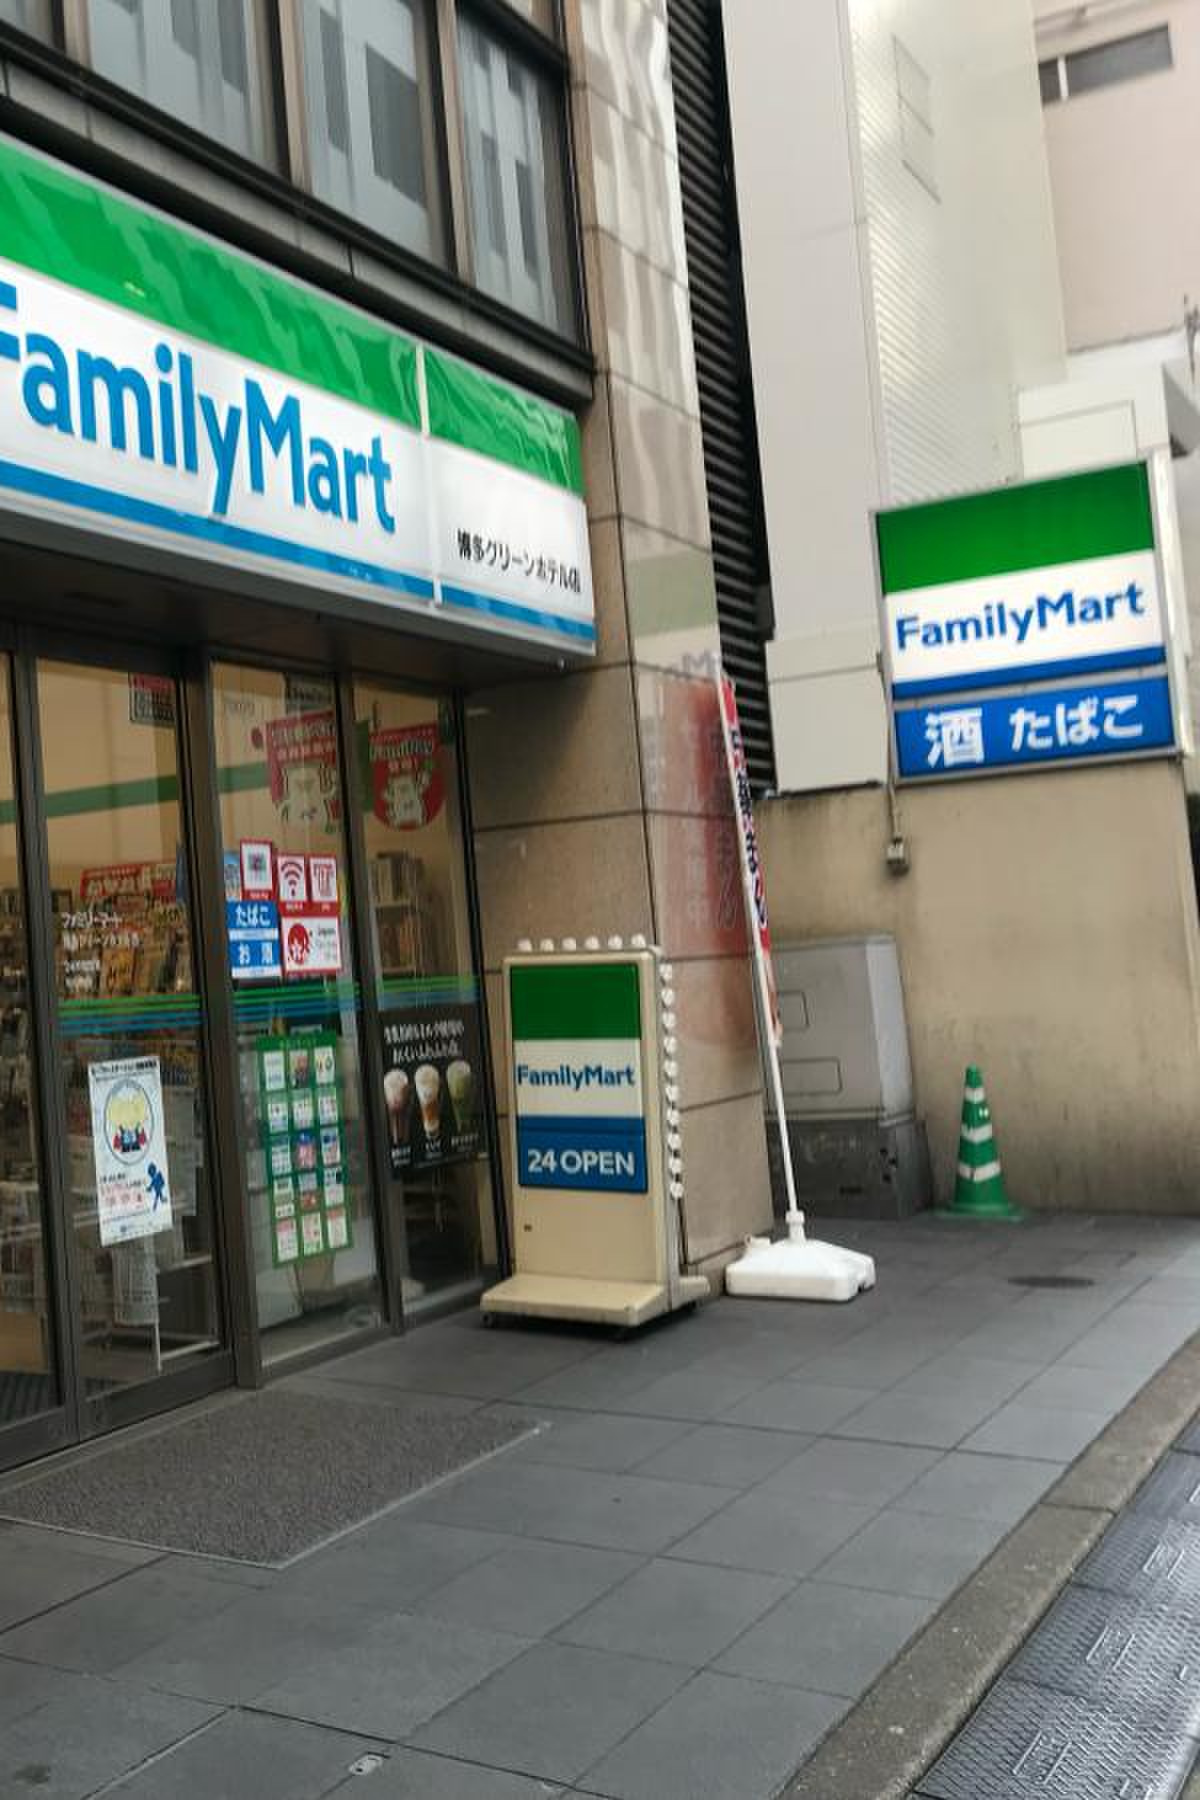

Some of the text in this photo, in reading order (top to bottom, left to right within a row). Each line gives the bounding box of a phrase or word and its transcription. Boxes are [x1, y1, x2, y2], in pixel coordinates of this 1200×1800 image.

[895, 582, 1145, 650] FamilyMart
[925, 694, 1143, 768] 酒 たばこ
[517, 1065, 634, 1091] FamilyMart
[527, 1149, 635, 1176] 24 OPEN
